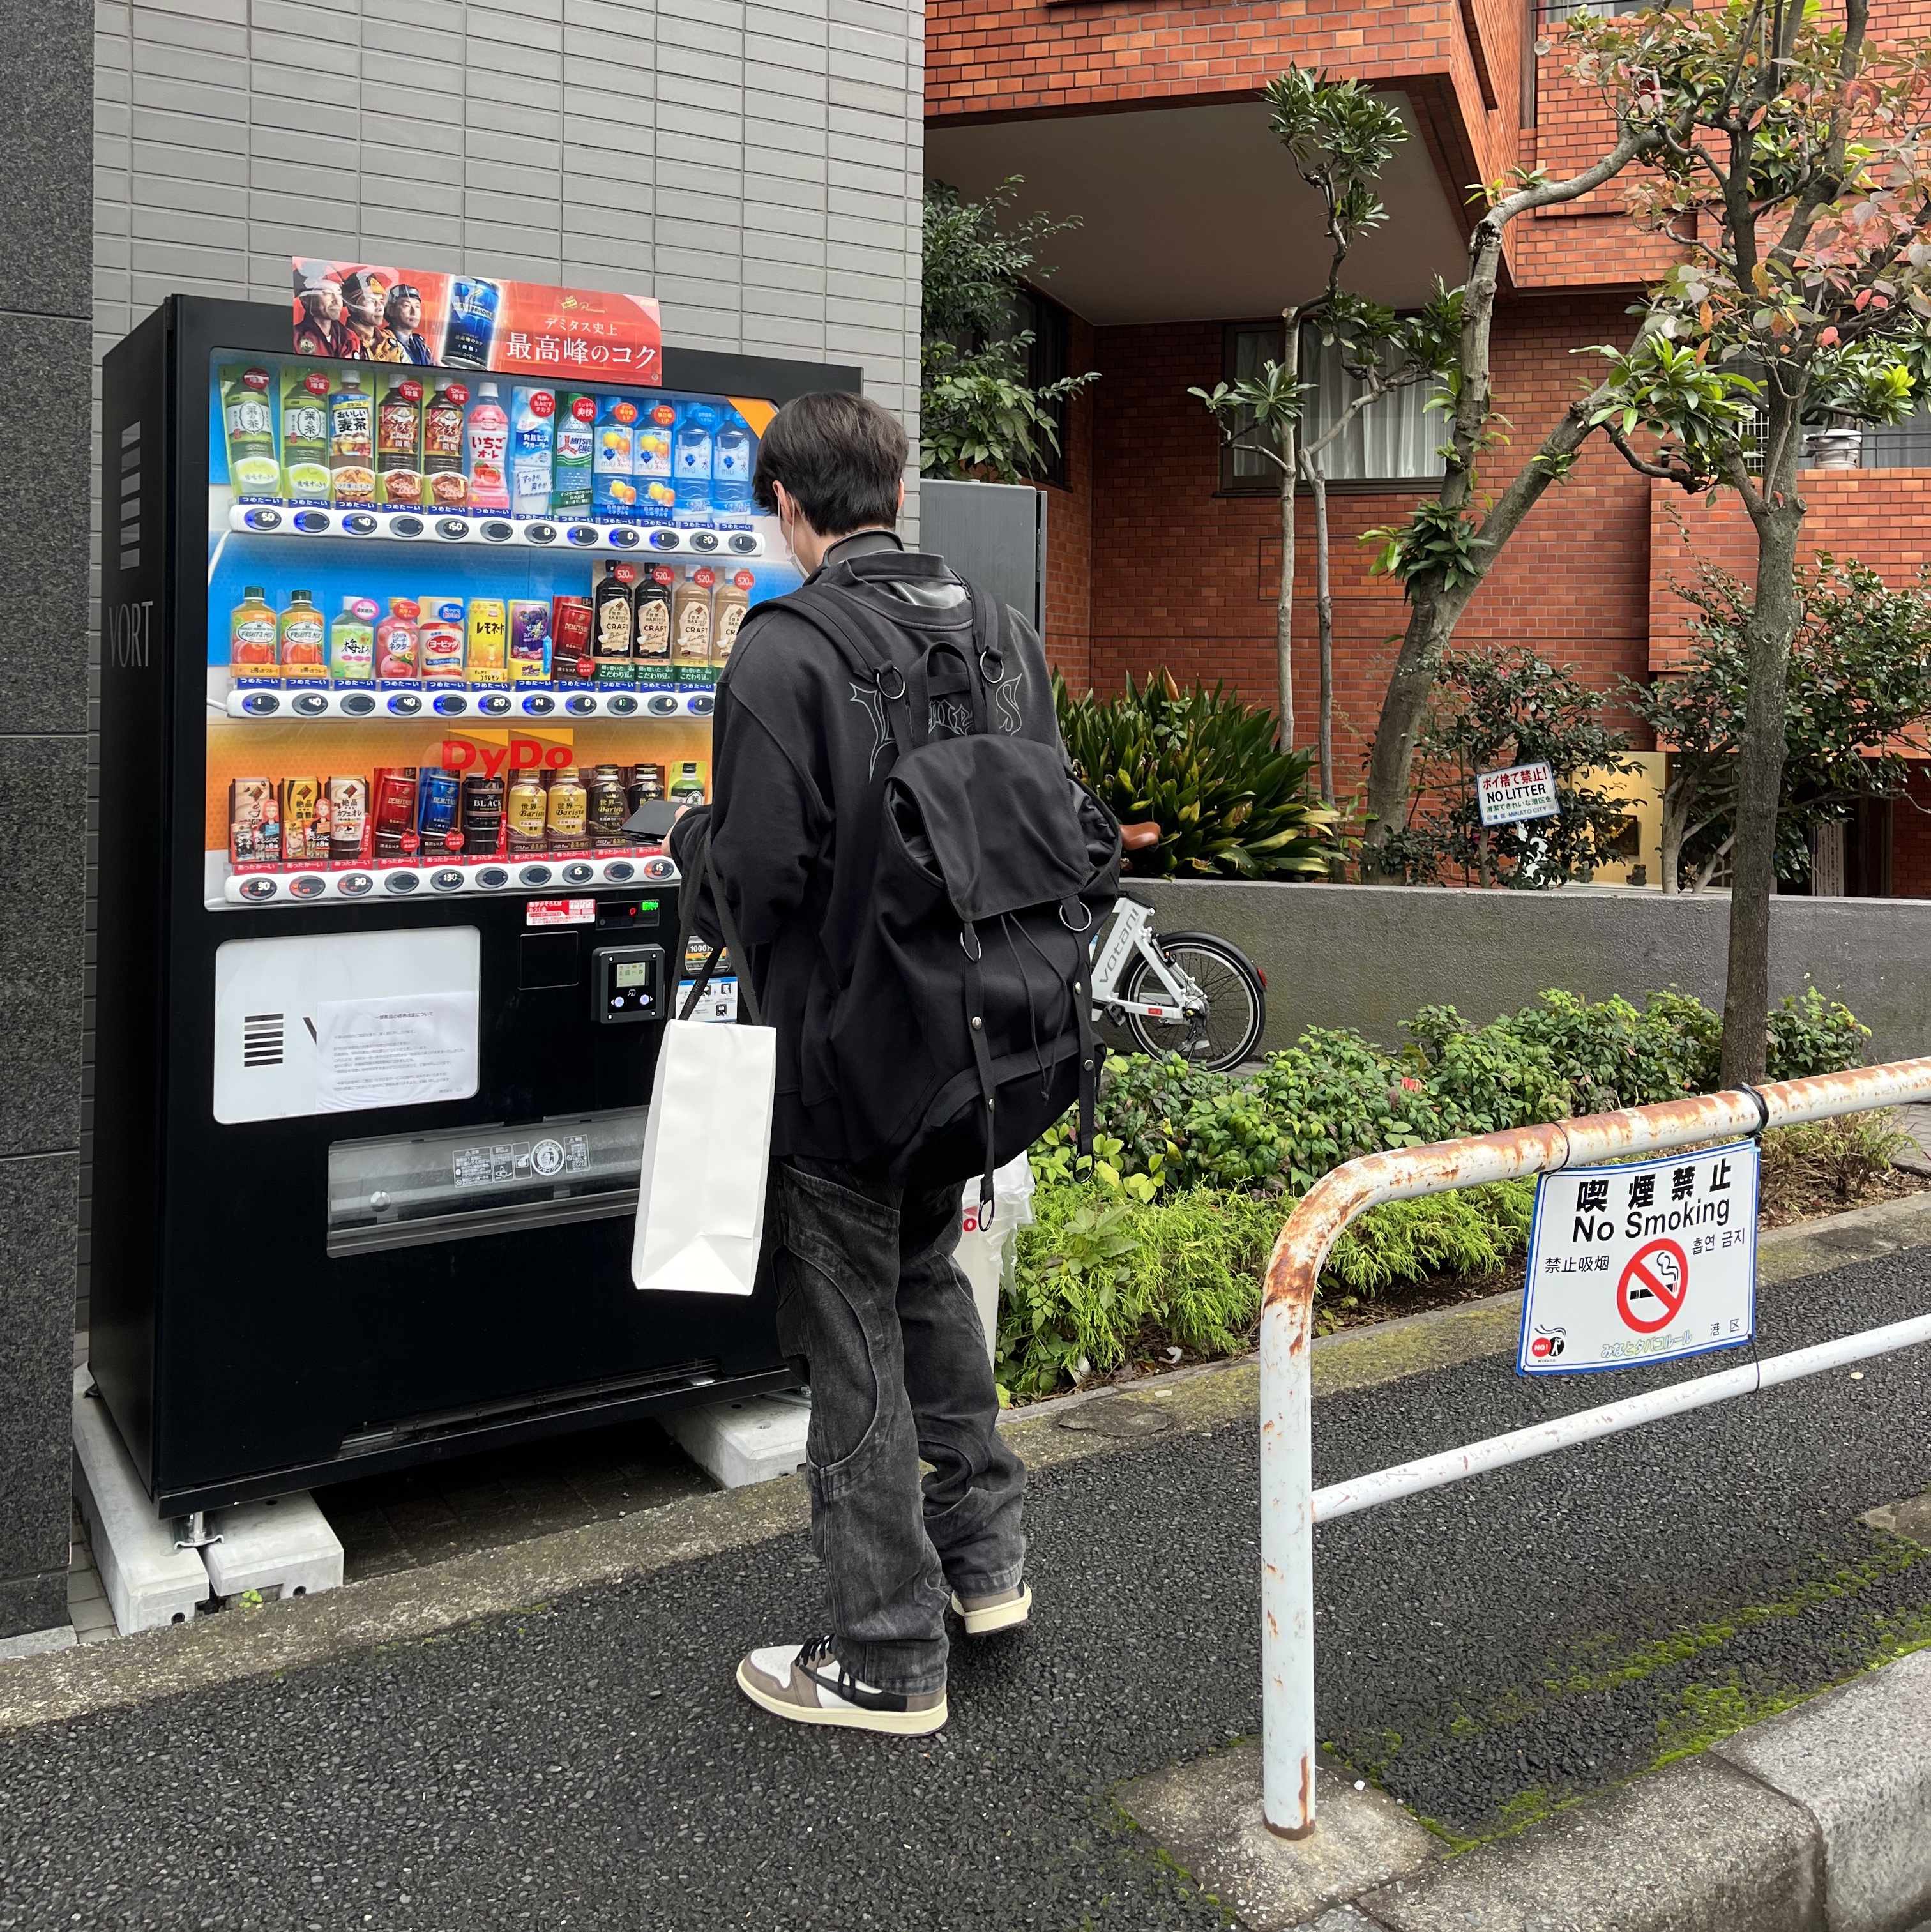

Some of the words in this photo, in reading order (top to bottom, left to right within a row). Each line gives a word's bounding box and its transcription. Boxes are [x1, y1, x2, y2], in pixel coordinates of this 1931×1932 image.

[545, 317, 618, 336] デミタス史上
[506, 331, 656, 370] 最高峰のコク
[337, 410, 366, 418] おいしい
[577, 408, 593, 417] 爽快
[338, 418, 367, 432] 麦茶
[472, 437, 506, 450] いちご
[109, 601, 153, 667] VORT
[476, 622, 504, 635] レモネード
[429, 640, 458, 649] ヨービック
[441, 740, 573, 780] DyDo
[1487, 791, 1503, 803] NO
[1505, 783, 1546, 800] LITTER
[1508, 809, 1531, 817] MINATO
[444, 873, 458, 881] 130
[1099, 908, 1139, 983] votani
[1572, 1215, 1614, 1243] No
[1625, 1198, 1730, 1238] Smoking
[1693, 1235, 1715, 1255] 흡연
[1721, 1228, 1746, 1249] 금지
[1545, 1255, 1610, 1273] 禁止吸烟
[1602, 1329, 1693, 1359] みなとタバコルール
